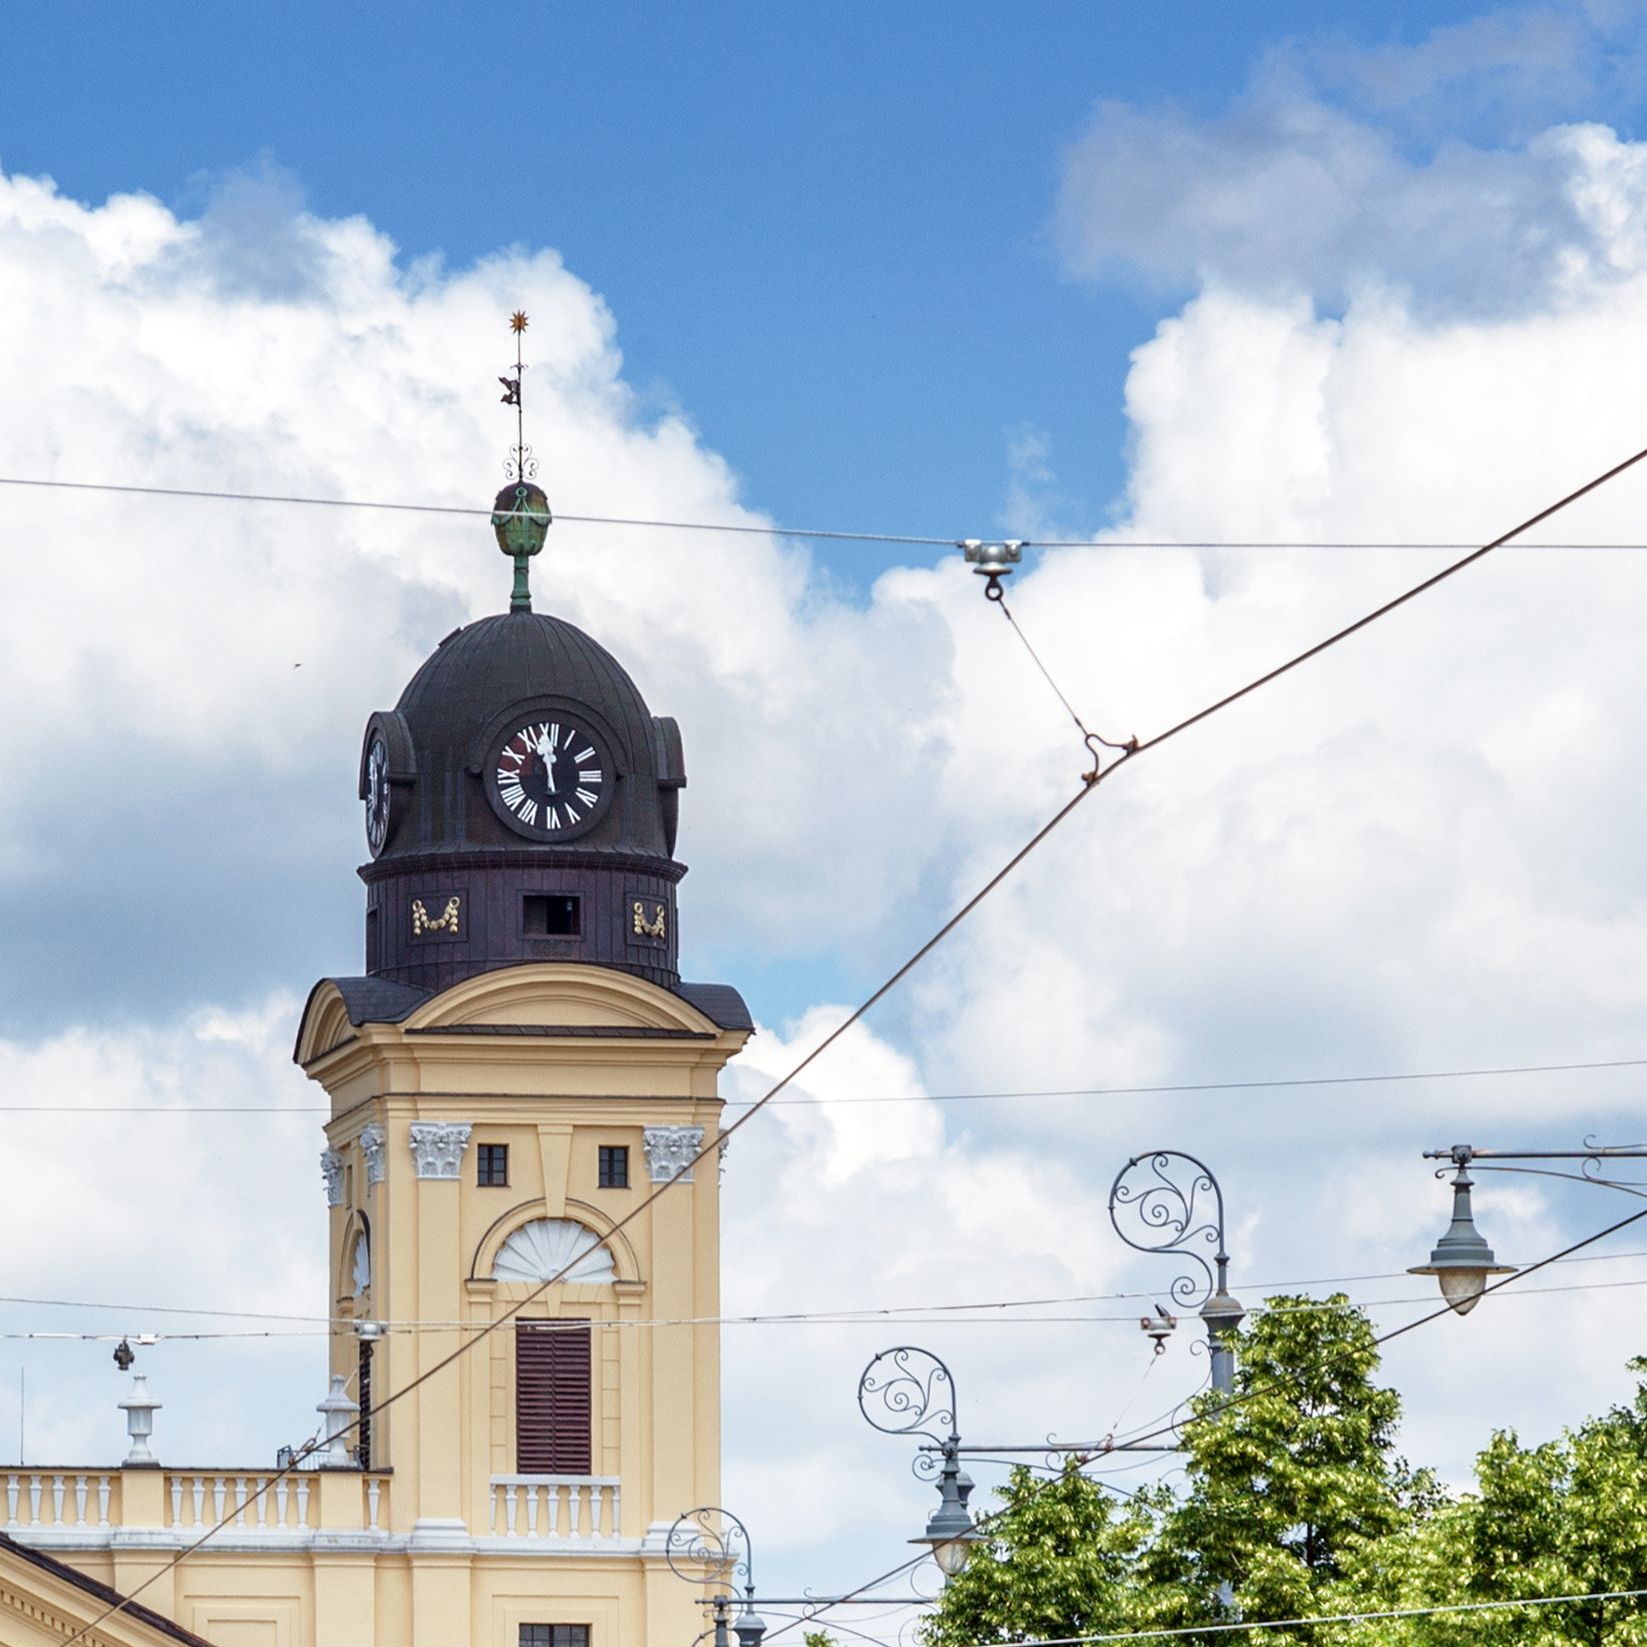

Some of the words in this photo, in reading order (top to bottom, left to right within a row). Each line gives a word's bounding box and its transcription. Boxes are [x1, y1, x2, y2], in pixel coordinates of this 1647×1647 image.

[517, 726, 539, 753] XI
[563, 729, 576, 751] I
[501, 745, 525, 765] X
[573, 746, 596, 764] II
[497, 768, 520, 784] IX
[579, 770, 602, 782] III
[500, 784, 527, 811] VIII
[574, 787, 599, 809] IV
[517, 799, 538, 826] VII
[546, 806, 561, 830] VI
[564, 802, 581, 825] V
